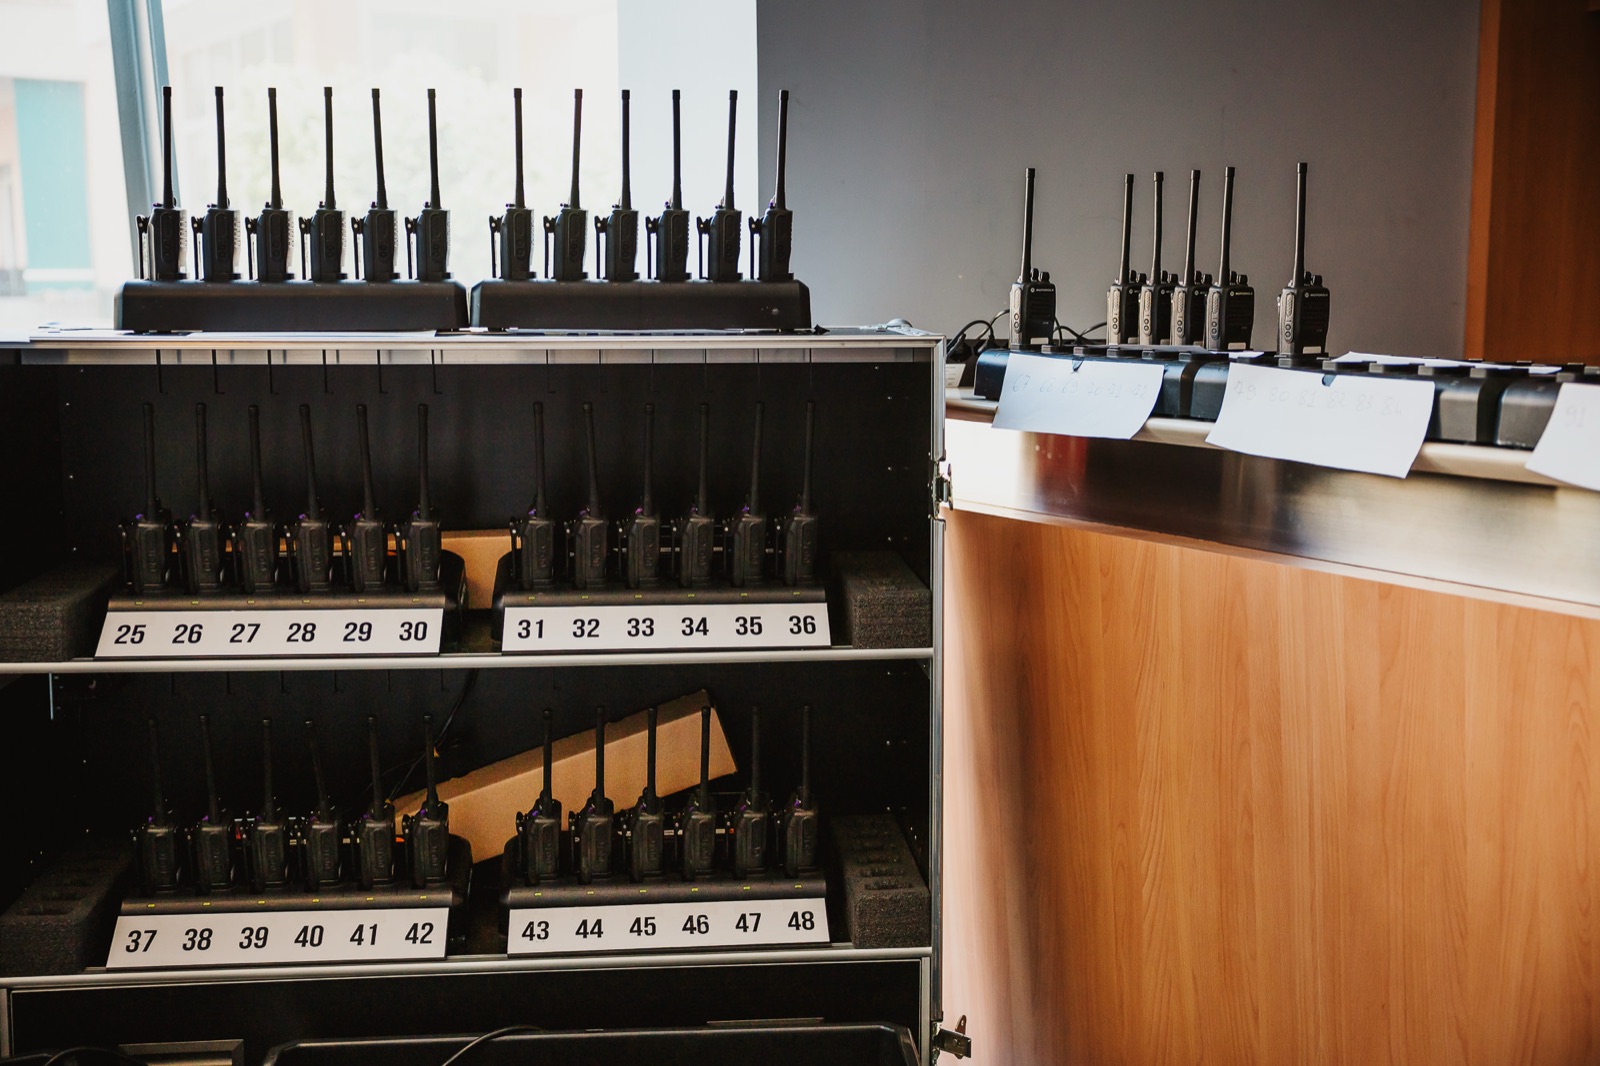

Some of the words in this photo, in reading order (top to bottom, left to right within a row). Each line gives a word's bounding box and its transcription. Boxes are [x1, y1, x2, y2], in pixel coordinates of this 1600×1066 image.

[1012, 374, 1030, 392] 67
[114, 625, 146, 644] 25
[172, 624, 203, 643] 26
[230, 624, 260, 643] 27
[287, 623, 316, 642] 28
[343, 622, 372, 641] 29
[399, 622, 427, 641] 30
[518, 620, 543, 638] 31
[573, 619, 599, 637] 32
[628, 618, 654, 637] 33
[682, 617, 709, 636] 34
[735, 617, 762, 635] 35
[789, 616, 816, 634] 36
[522, 921, 549, 941] 43
[576, 919, 603, 938] 44
[630, 917, 656, 936] 45
[682, 915, 709, 934] 46
[736, 913, 761, 932] 47
[788, 911, 814, 930] 48
[126, 930, 157, 952] 37
[183, 928, 213, 951] 38
[239, 927, 268, 949] 39
[294, 925, 324, 947] 40
[350, 924, 377, 945] 41
[405, 923, 433, 944] 42
